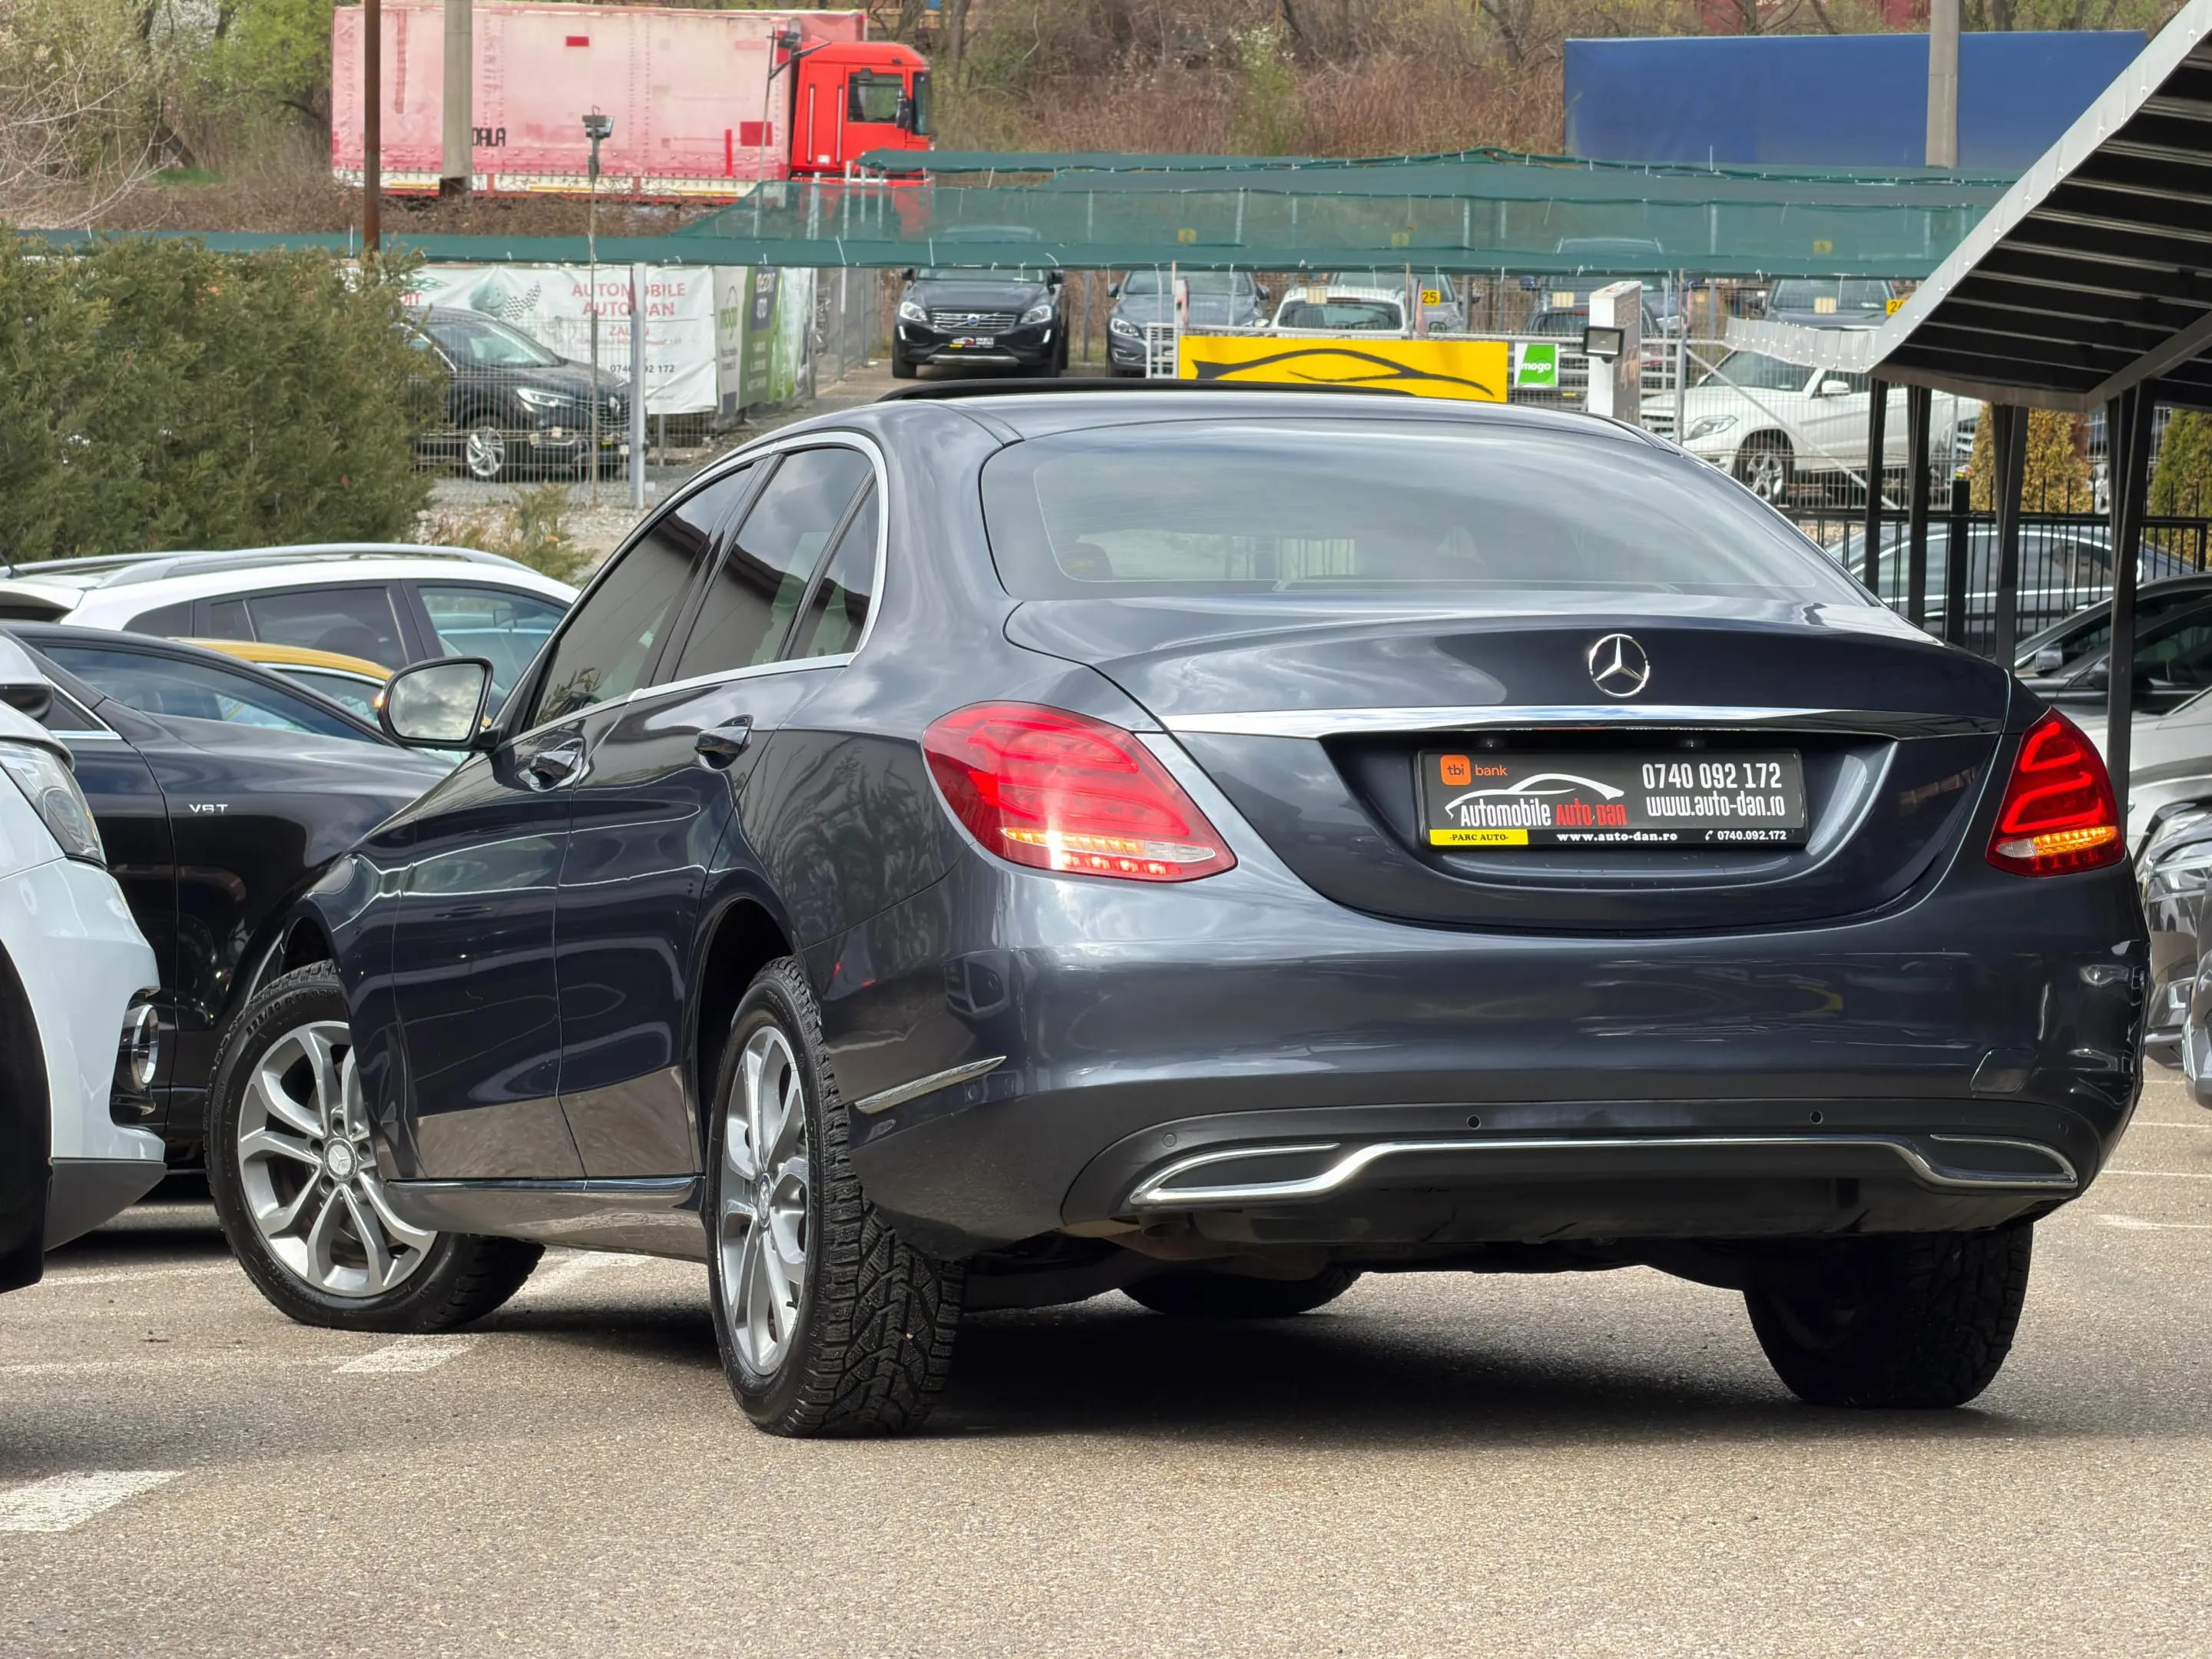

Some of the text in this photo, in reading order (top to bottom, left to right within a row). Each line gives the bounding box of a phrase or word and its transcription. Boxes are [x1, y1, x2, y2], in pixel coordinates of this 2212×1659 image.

[1422, 292, 1437, 304] 25
[657, 364, 675, 373] 172
[1522, 362, 1552, 374] mogo
[1447, 763, 1508, 777] tbi bank
[1642, 763, 1783, 789] 0740 092 172
[1646, 790, 1786, 816] www.auto-dan.ro
[1461, 798, 1551, 827] Automobile
[1556, 831, 1678, 842] www.auto-dan.ro
[1717, 830, 1787, 840] 0740.092.172
